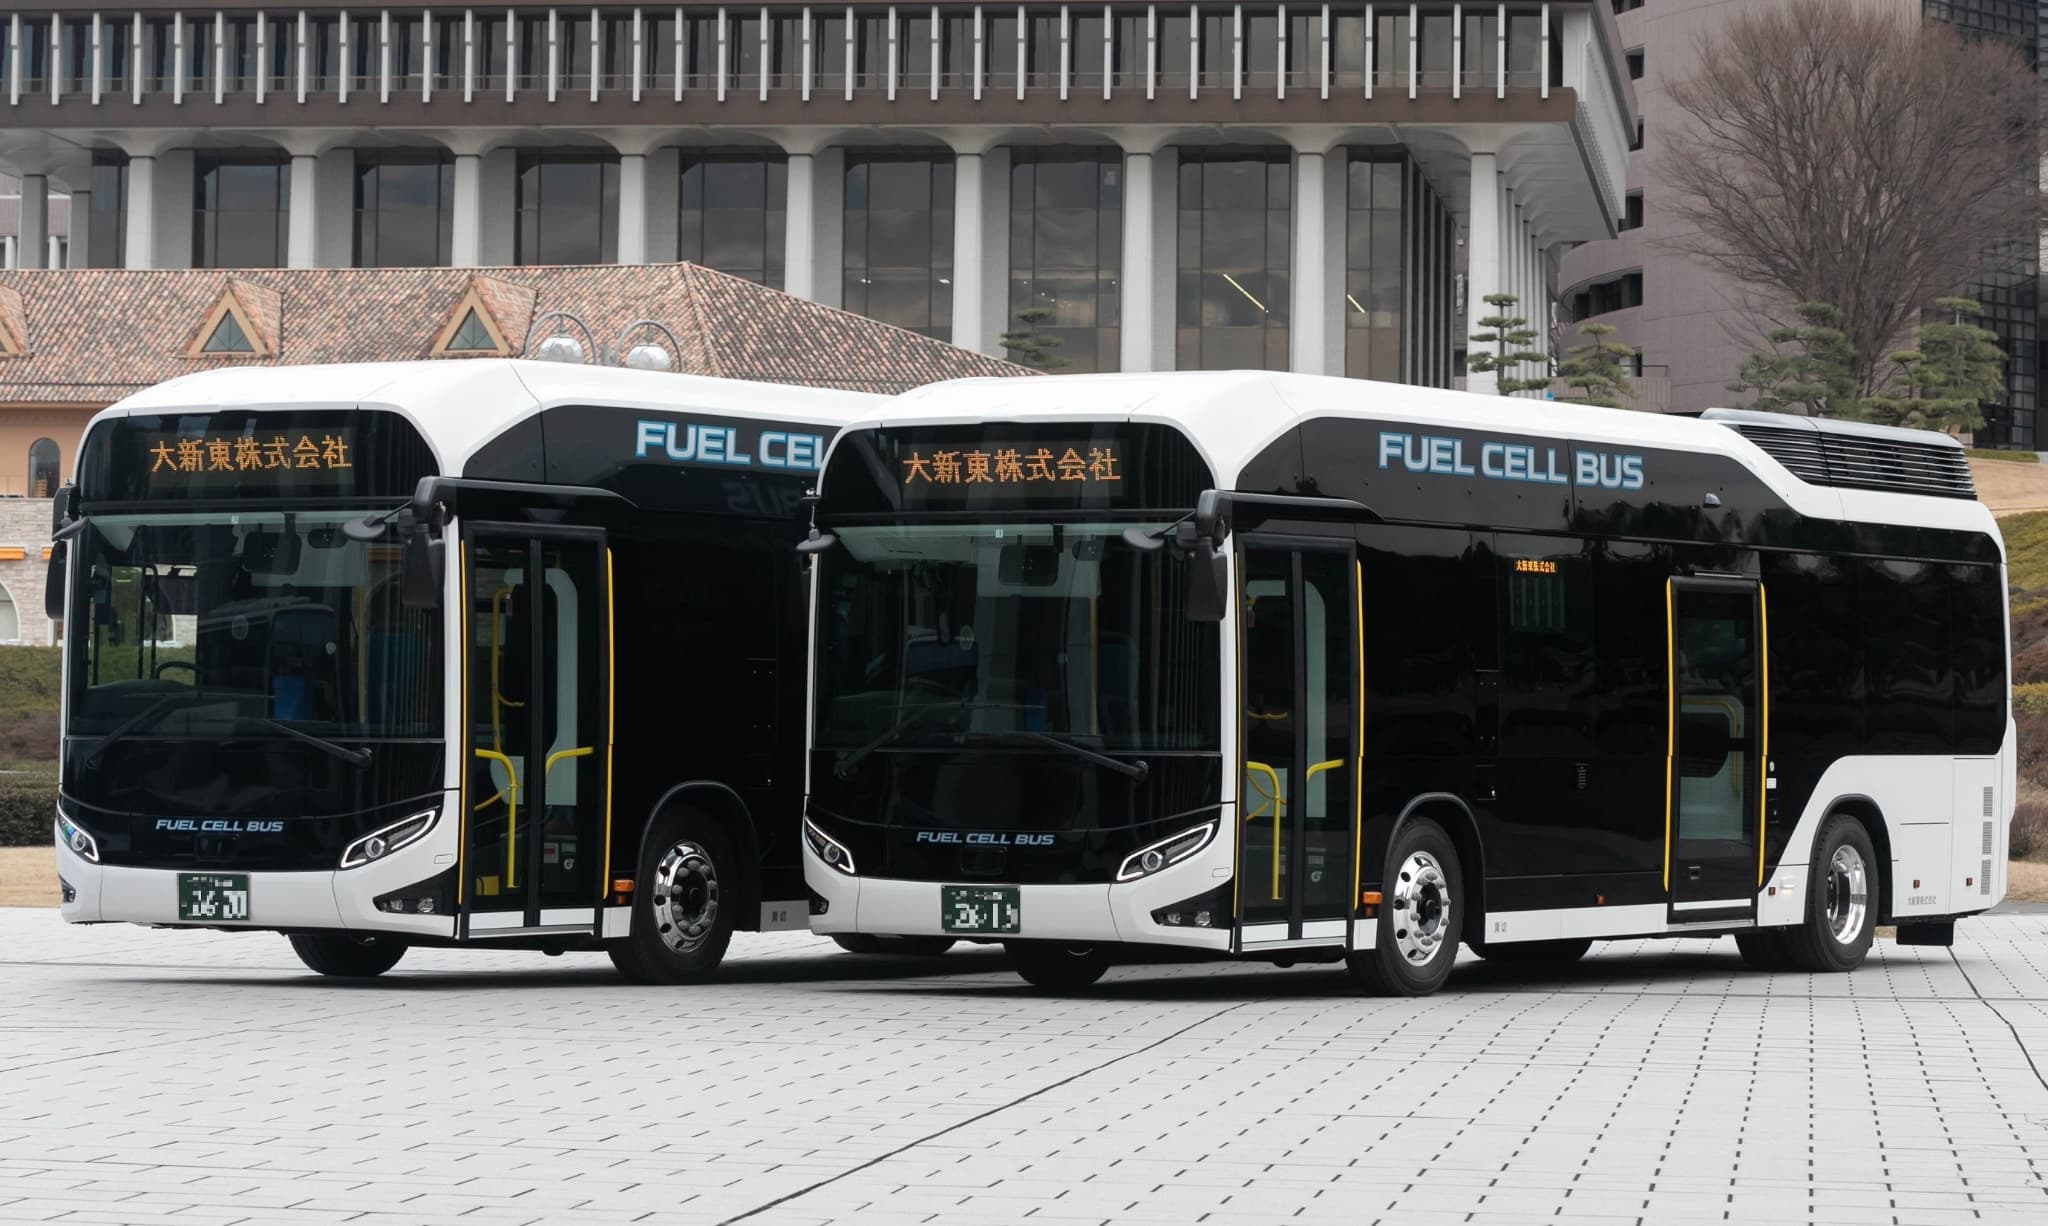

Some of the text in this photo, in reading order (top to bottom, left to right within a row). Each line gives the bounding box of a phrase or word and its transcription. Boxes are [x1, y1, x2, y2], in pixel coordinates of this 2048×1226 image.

[150, 435, 353, 472] 大新東株式会社
[635, 420, 752, 465] FUEL
[1378, 431, 1645, 489] FUEL CELL BUS
[903, 447, 1121, 484] 大新東株式会社
[155, 819, 284, 832] FUEL CELL BUS
[916, 831, 1055, 845] FUEL CELL BUS
